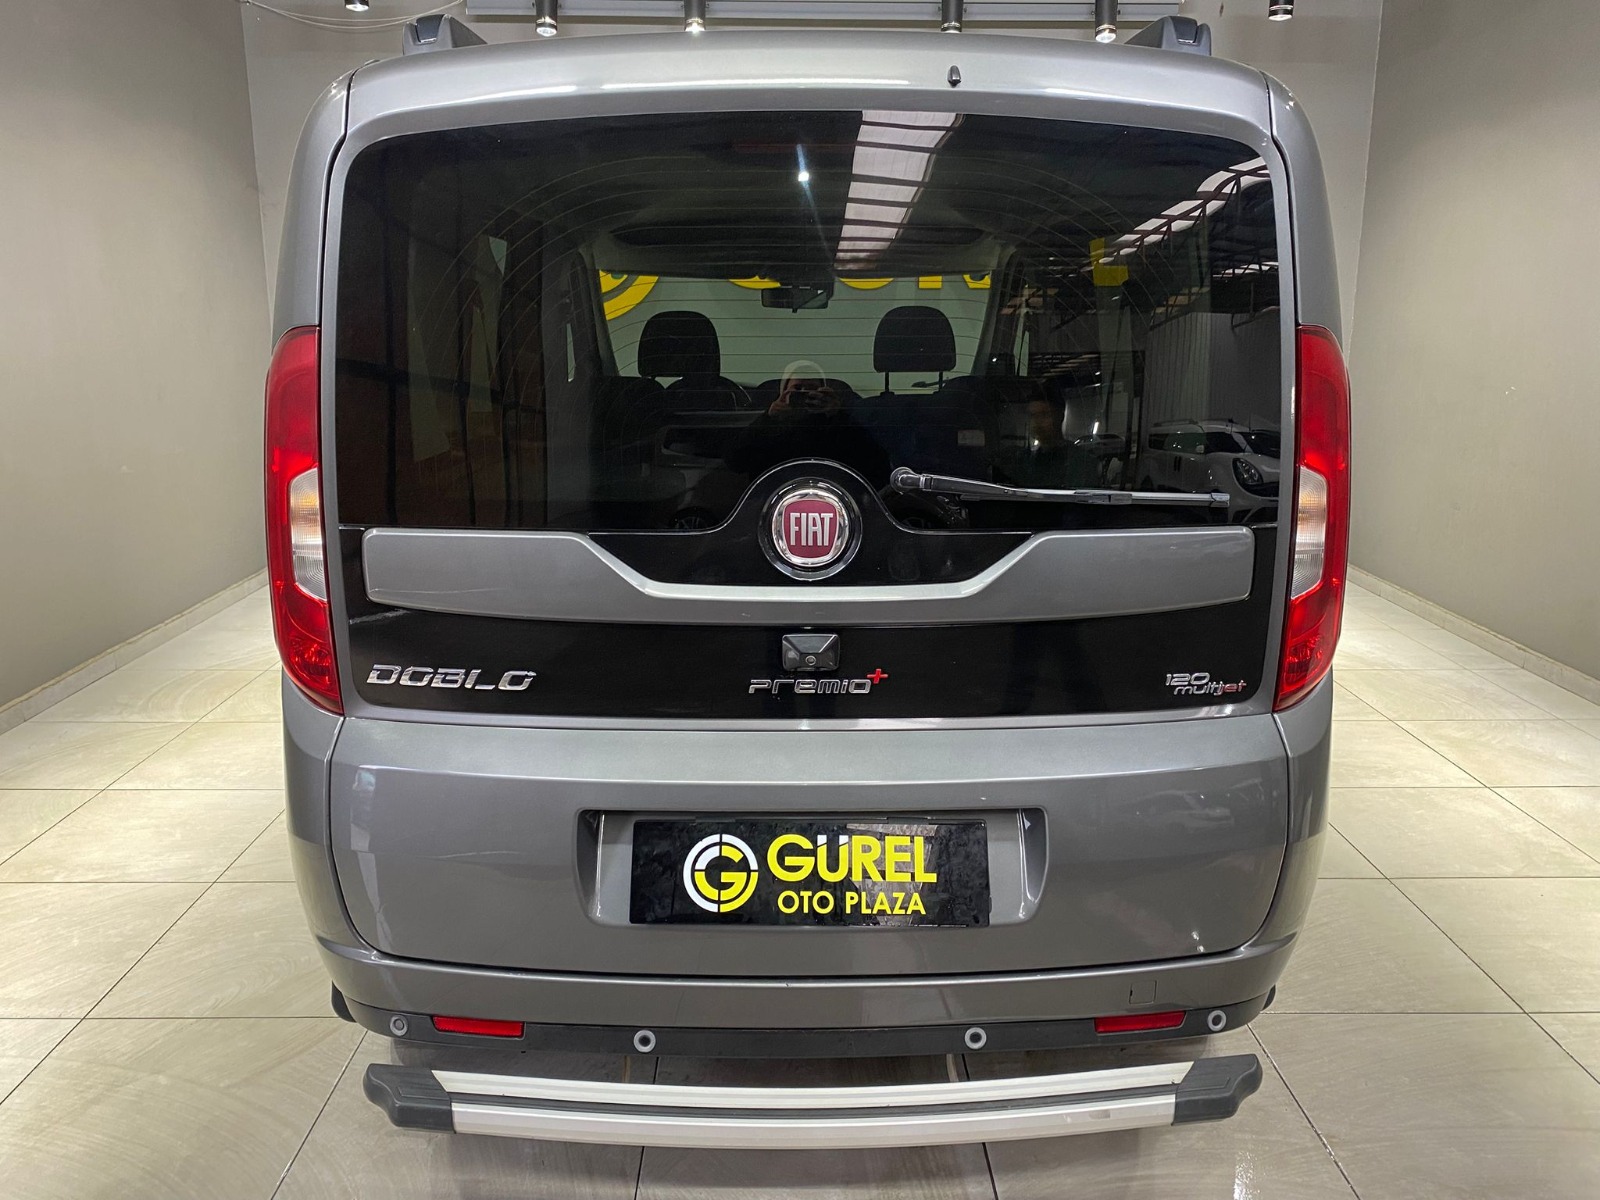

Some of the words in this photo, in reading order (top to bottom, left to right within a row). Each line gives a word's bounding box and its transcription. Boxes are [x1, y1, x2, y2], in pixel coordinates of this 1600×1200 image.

[789, 512, 833, 546] FIAT
[1165, 672, 1210, 686] 120
[777, 890, 835, 915] OTO
[845, 891, 927, 915] PLAZA
